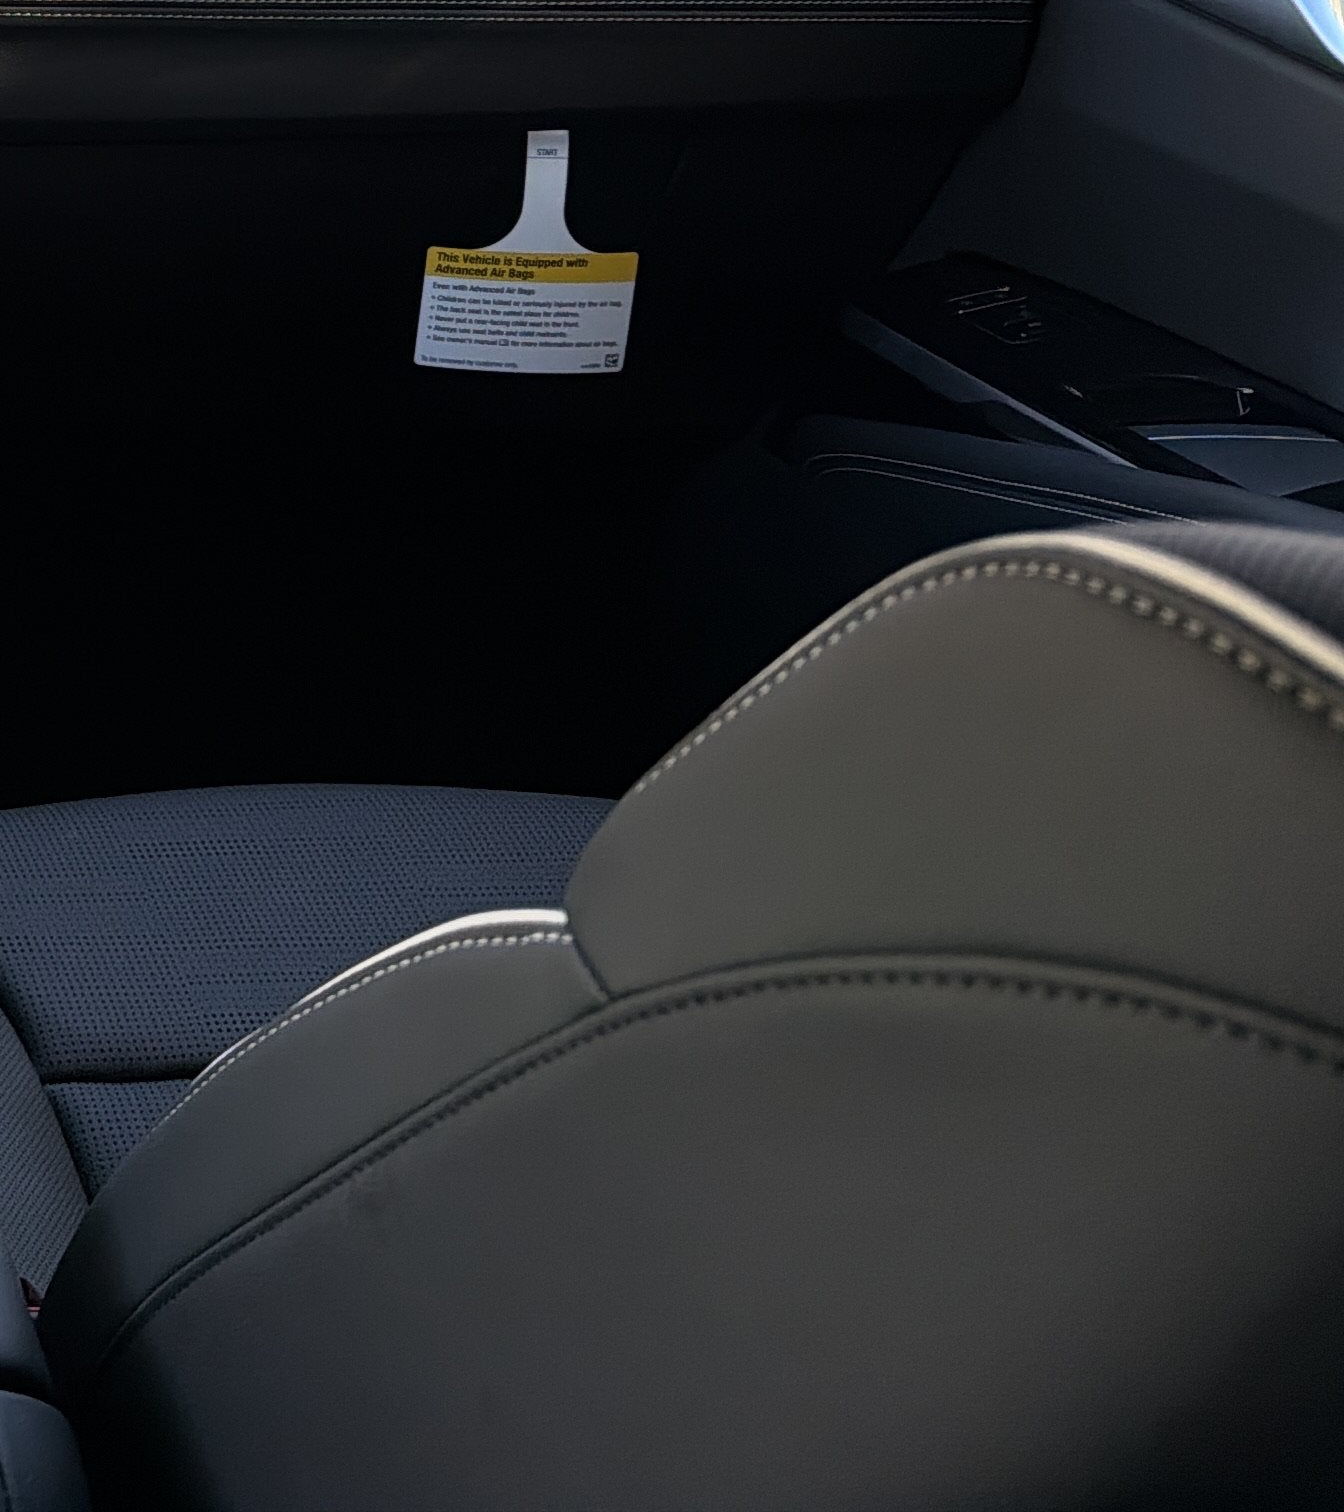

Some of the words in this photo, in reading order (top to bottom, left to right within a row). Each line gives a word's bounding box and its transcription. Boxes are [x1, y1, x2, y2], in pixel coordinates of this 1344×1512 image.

[437, 252, 460, 263] This
[462, 254, 501, 265] Vehicle
[503, 256, 513, 266] is
[515, 257, 564, 268] Equipped
[565, 258, 589, 267] with
[434, 264, 488, 276] Advanced
[490, 268, 506, 277] Air
[508, 268, 535, 280] Bags
